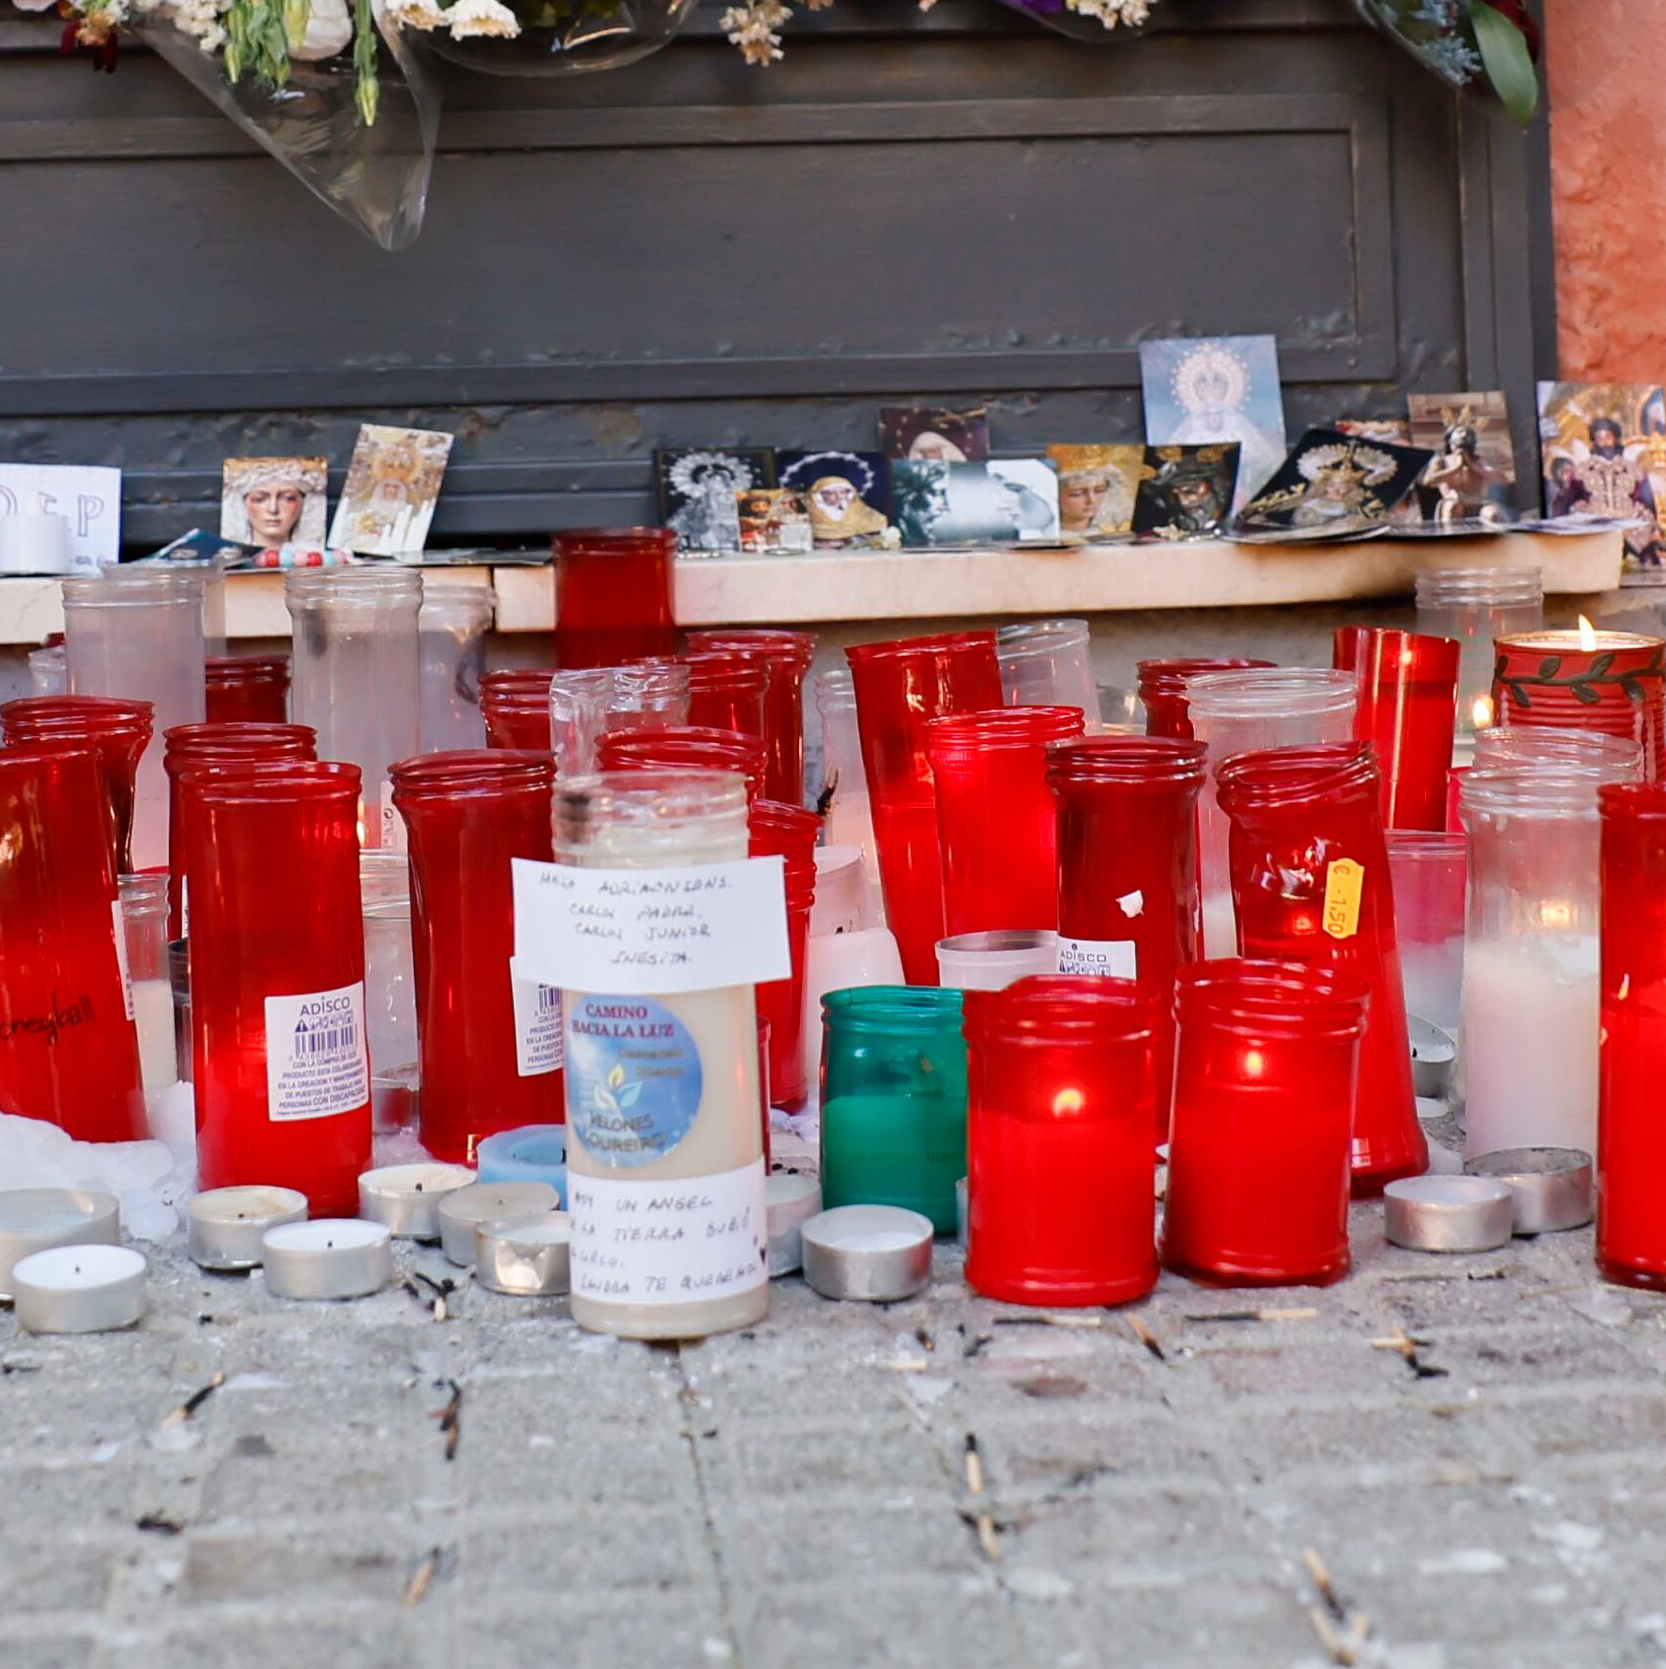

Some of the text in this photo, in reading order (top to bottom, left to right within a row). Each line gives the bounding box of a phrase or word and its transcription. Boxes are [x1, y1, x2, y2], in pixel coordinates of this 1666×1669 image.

[586, 1003, 649, 1019] CAMINO
[614, 1024, 636, 1038] LA
[640, 1023, 675, 1038] LUZ
